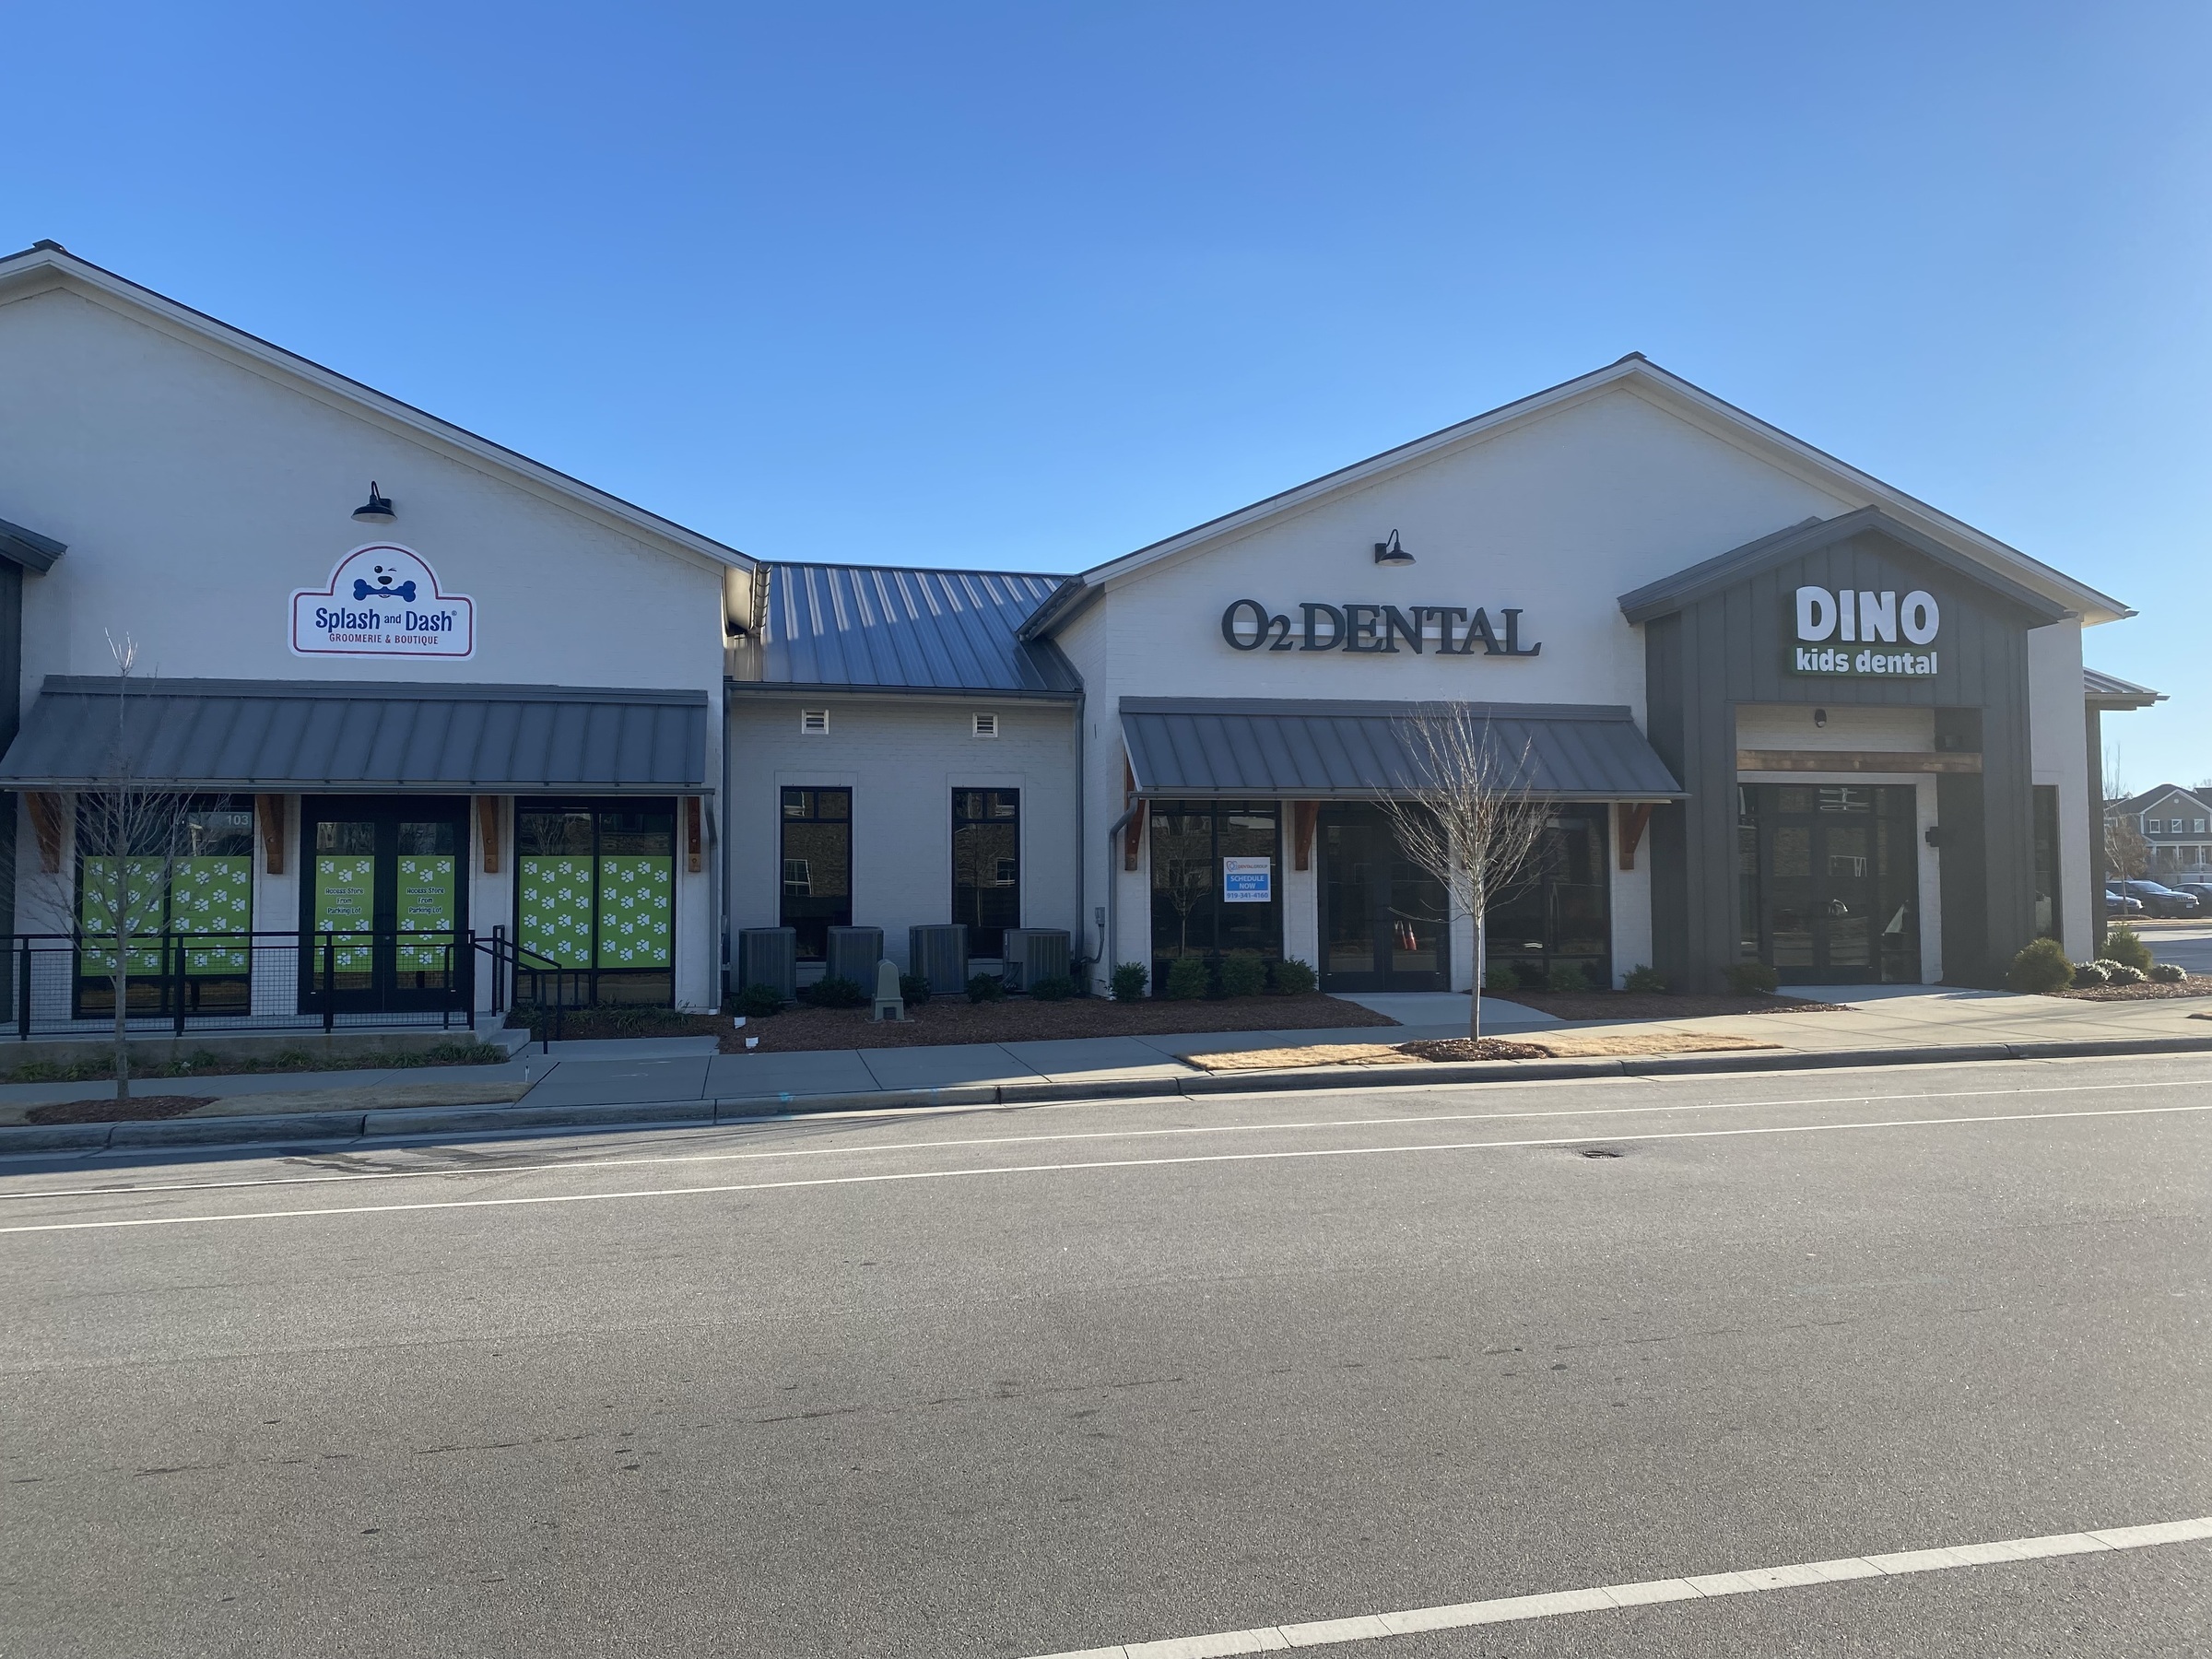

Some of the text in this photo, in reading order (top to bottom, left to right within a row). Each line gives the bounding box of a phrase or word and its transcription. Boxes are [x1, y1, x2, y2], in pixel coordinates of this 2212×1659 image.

[315, 607, 381, 633] Splash
[383, 614, 402, 624] and
[1796, 586, 1940, 644] DINO
[329, 633, 439, 645] GROOMERIE & BOUTIQUE
[1796, 647, 1938, 675] kids dental
[226, 815, 249, 826] 103
